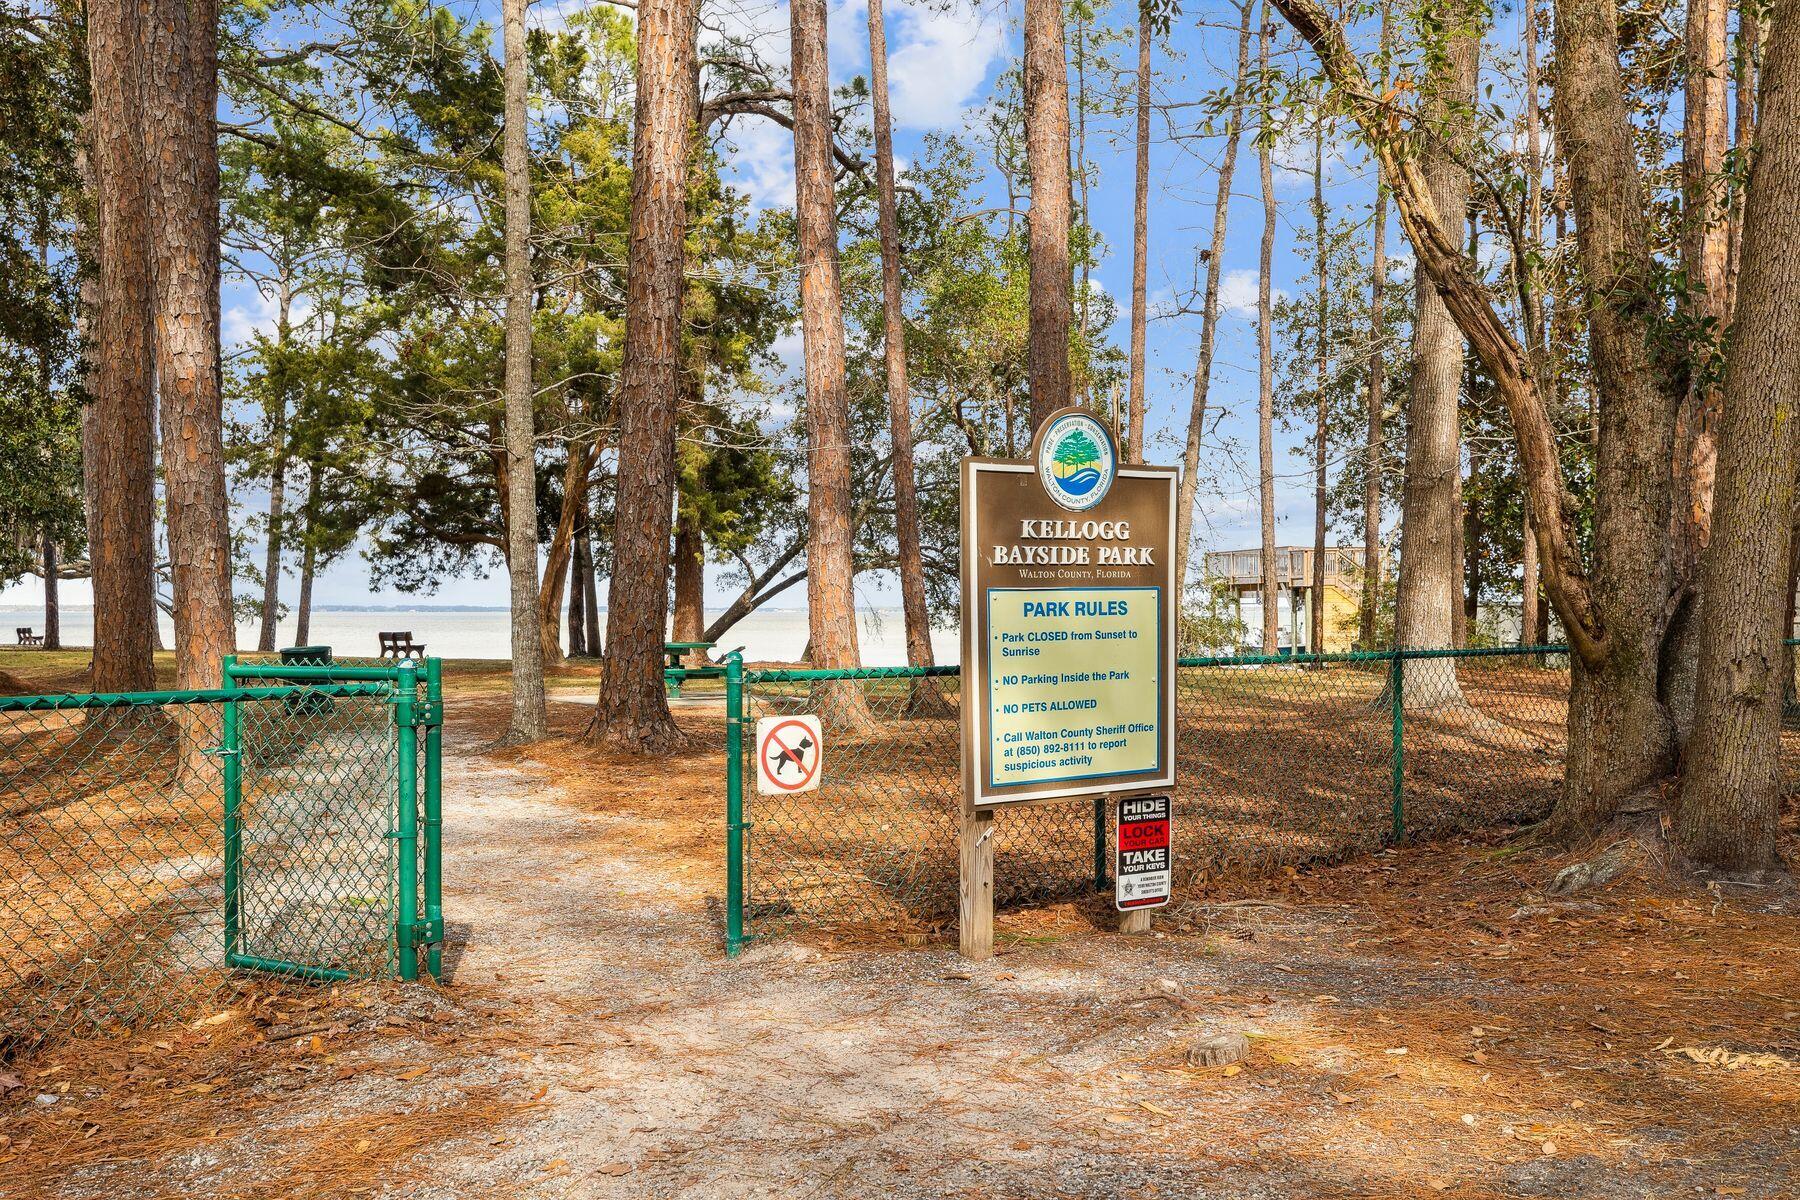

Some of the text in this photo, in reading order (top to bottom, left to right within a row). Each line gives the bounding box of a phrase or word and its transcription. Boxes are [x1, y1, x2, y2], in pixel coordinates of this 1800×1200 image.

[1045, 466, 1063, 497] WALTON
[1090, 468, 1109, 499] FLORIDA
[1020, 519, 1130, 541] KELLOGG
[993, 545, 1155, 566] BAYSIDE PARK
[1023, 600, 1129, 617] PARK RULES
[1002, 630, 1138, 643] Park CLOSED from Sunset to
[1002, 647, 1040, 657] Sunrise
[1002, 670, 1130, 686] NO Parking Inside the Park
[1003, 699, 1097, 714] NO PETS ALLOWED
[1003, 723, 1154, 743] Call Walton County Sheriff Office
[1003, 738, 1127, 757] at (850) 892-8111 to report
[1004, 754, 1093, 772] suspicious activity
[1123, 799, 1166, 815] HIDE
[1123, 812, 1166, 822] YOUR THINGS
[1123, 824, 1164, 839] LOCK
[1149, 837, 1165, 845] CAR
[1122, 848, 1166, 865] TAKE
[1123, 862, 1166, 873] YOUR KEYS
